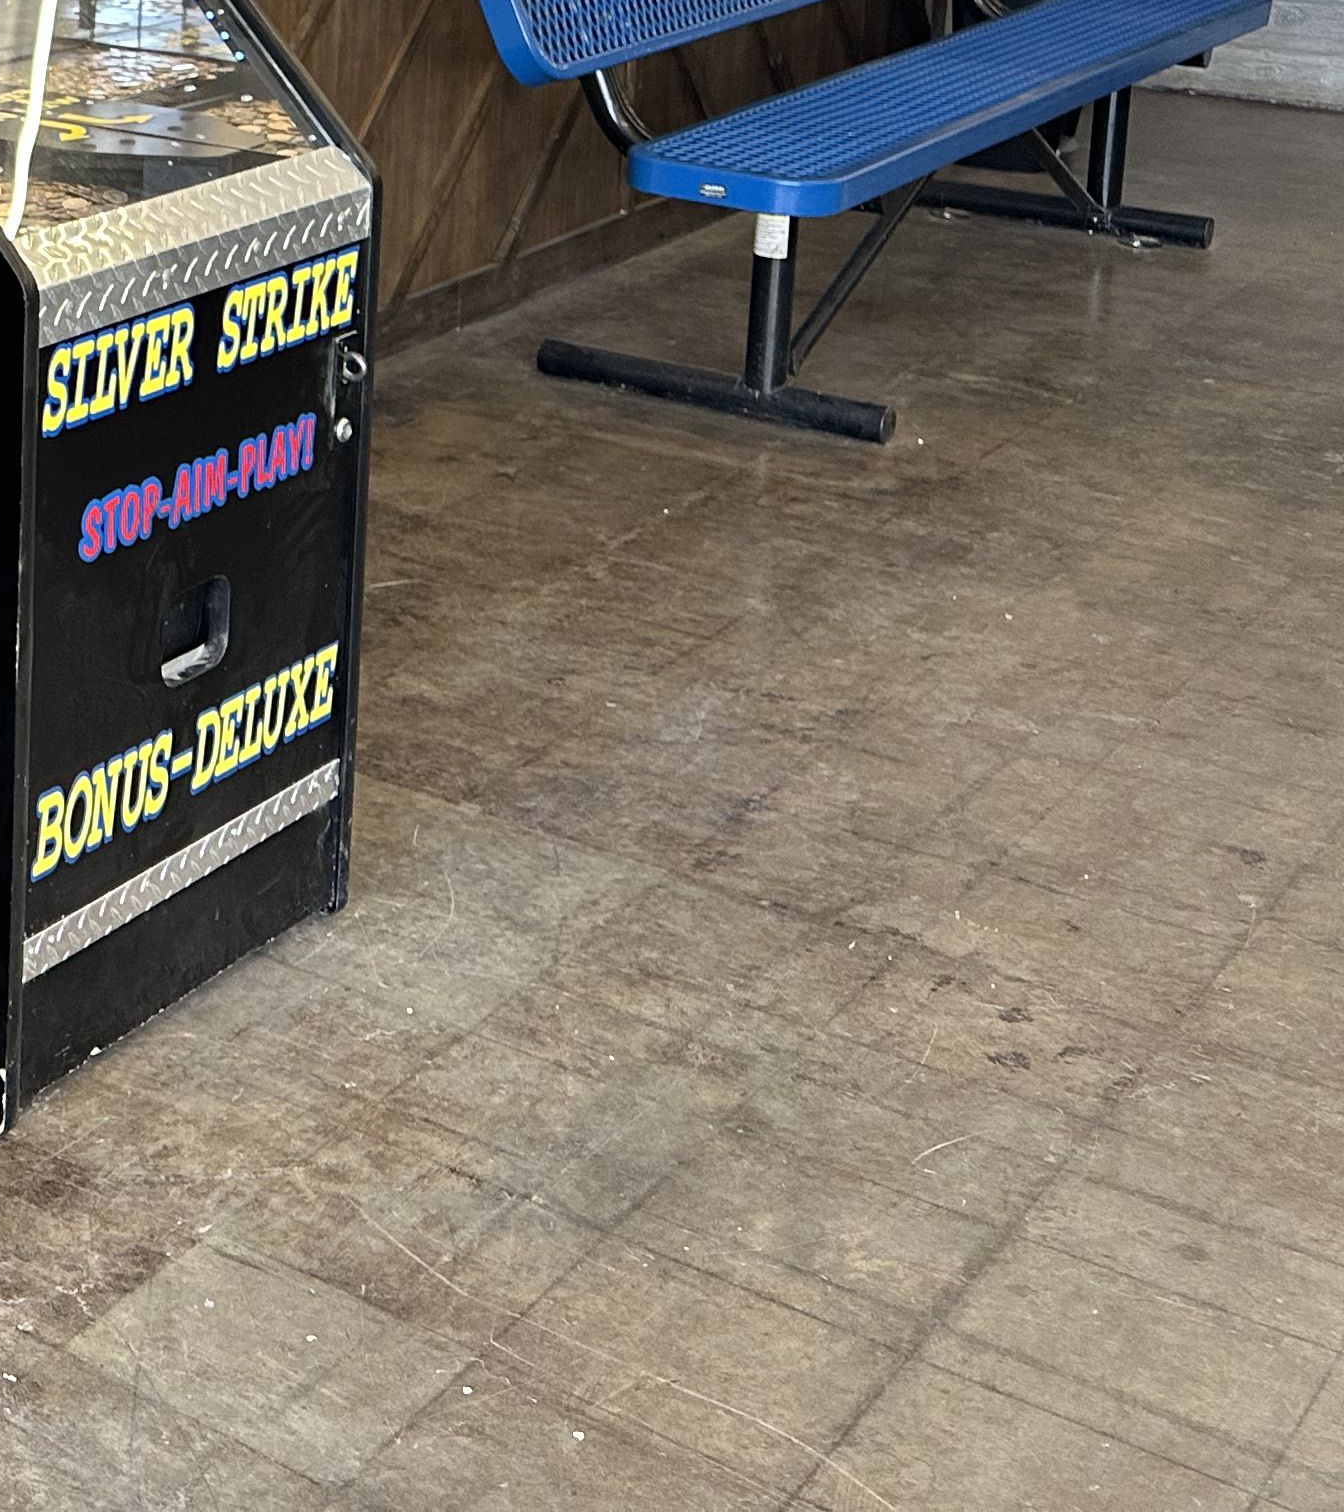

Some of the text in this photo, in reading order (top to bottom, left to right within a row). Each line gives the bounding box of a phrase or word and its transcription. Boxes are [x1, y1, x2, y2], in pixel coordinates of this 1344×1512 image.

[42, 245, 361, 437] SILVER STRIKE
[78, 412, 316, 563] STOP-AIM-PLAY!
[30, 640, 340, 883] BONUS-DELUXE
